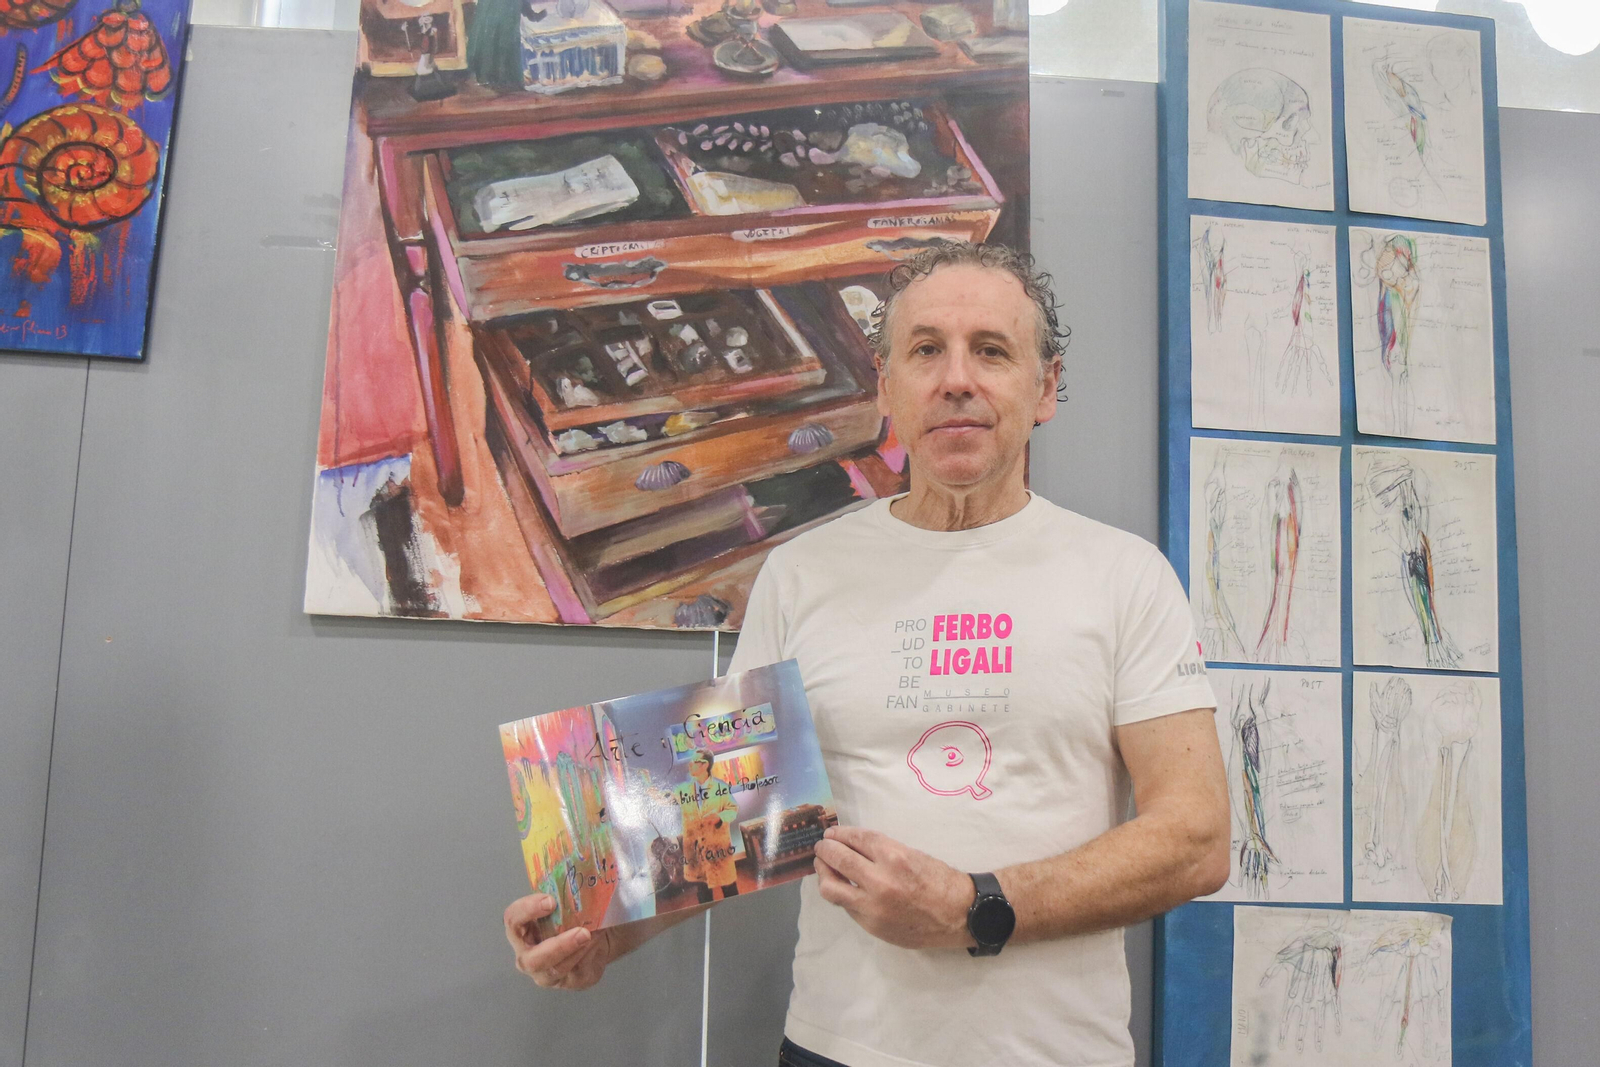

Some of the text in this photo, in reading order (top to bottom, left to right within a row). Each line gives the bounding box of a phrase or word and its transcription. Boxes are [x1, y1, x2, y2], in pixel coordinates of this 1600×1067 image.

[894, 613, 1014, 642] PRO FERBO
[902, 656, 923, 670] TO
[929, 645, 1013, 676] LIGALI
[898, 675, 1011, 698] BE MUSEO
[886, 695, 1010, 713] FAN GABINETE
[584, 732, 645, 762] Arte
[683, 707, 766, 740] Ciencia
[715, 782, 733, 797] del
[738, 774, 781, 796] Profesor
